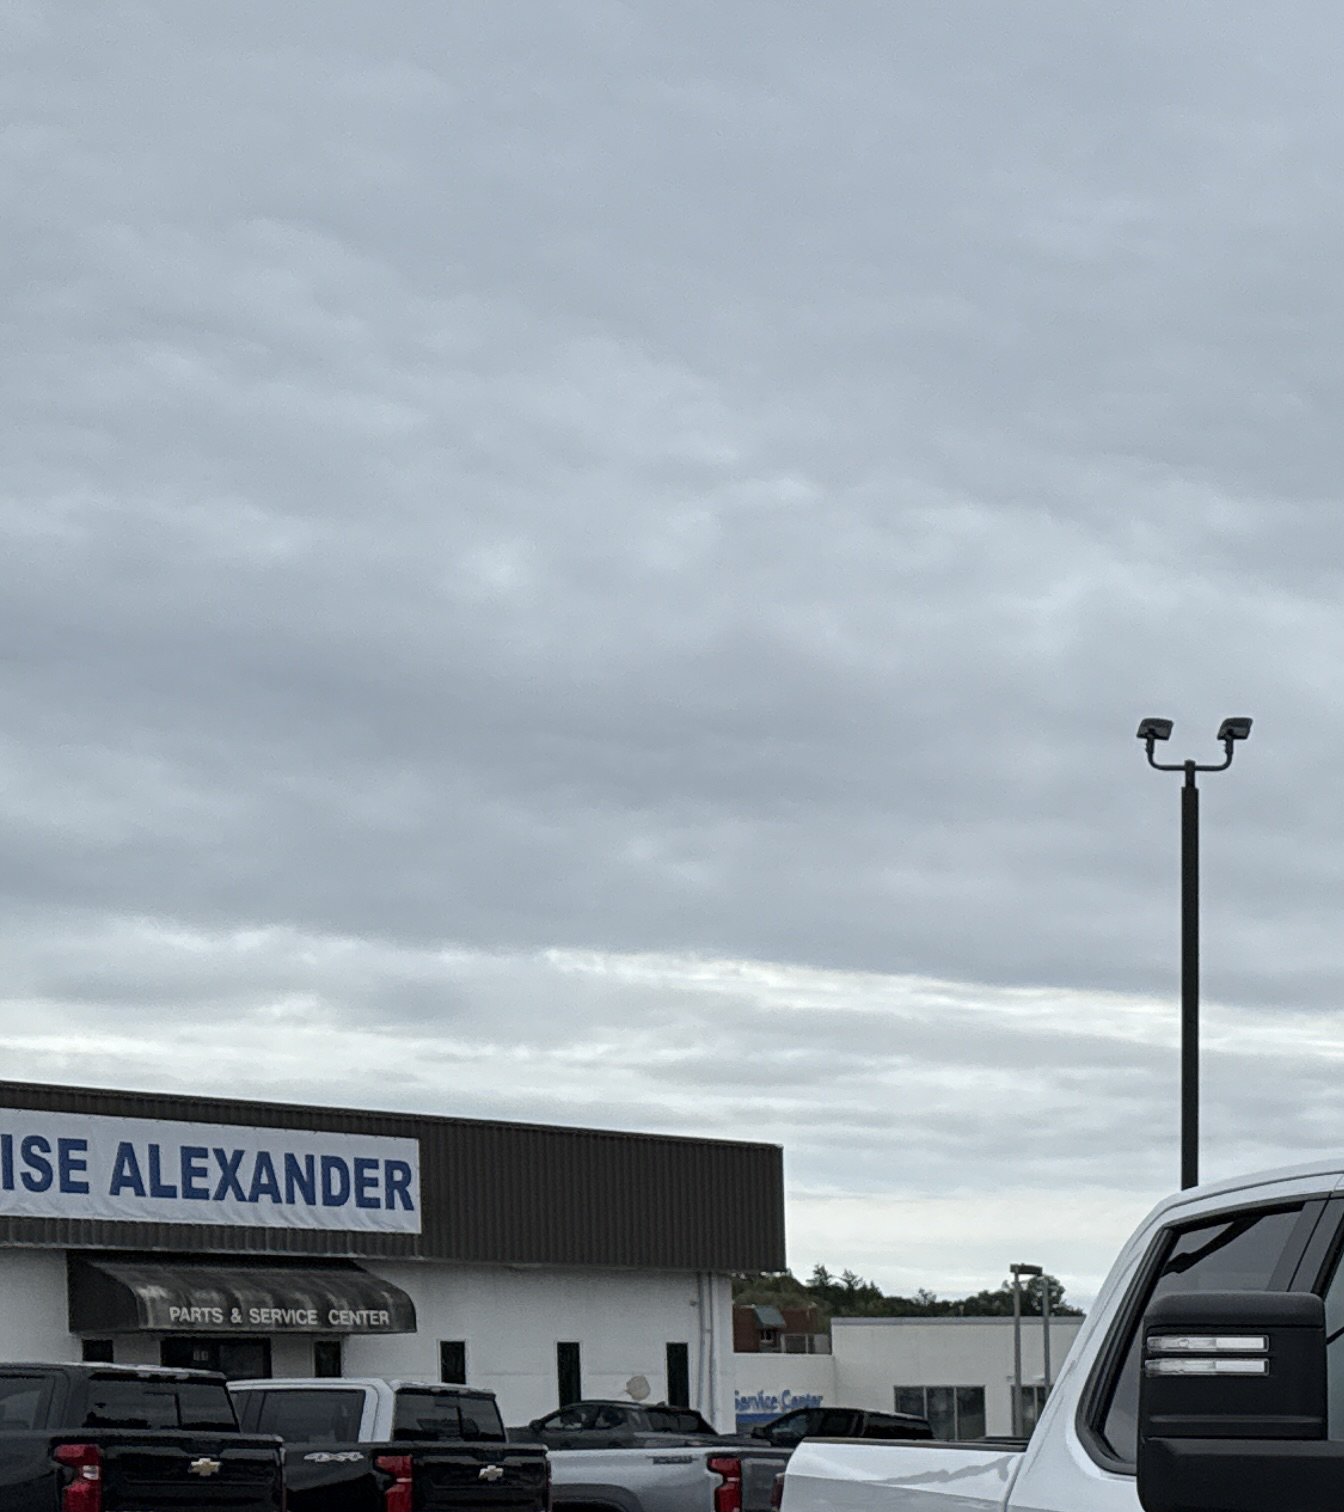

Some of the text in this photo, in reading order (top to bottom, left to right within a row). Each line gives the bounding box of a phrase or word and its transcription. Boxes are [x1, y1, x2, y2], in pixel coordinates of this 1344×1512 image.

[0, 1132, 415, 1212] ISE ALEXANDER
[169, 1306, 390, 1327] PARTS & SERVICE CENTER
